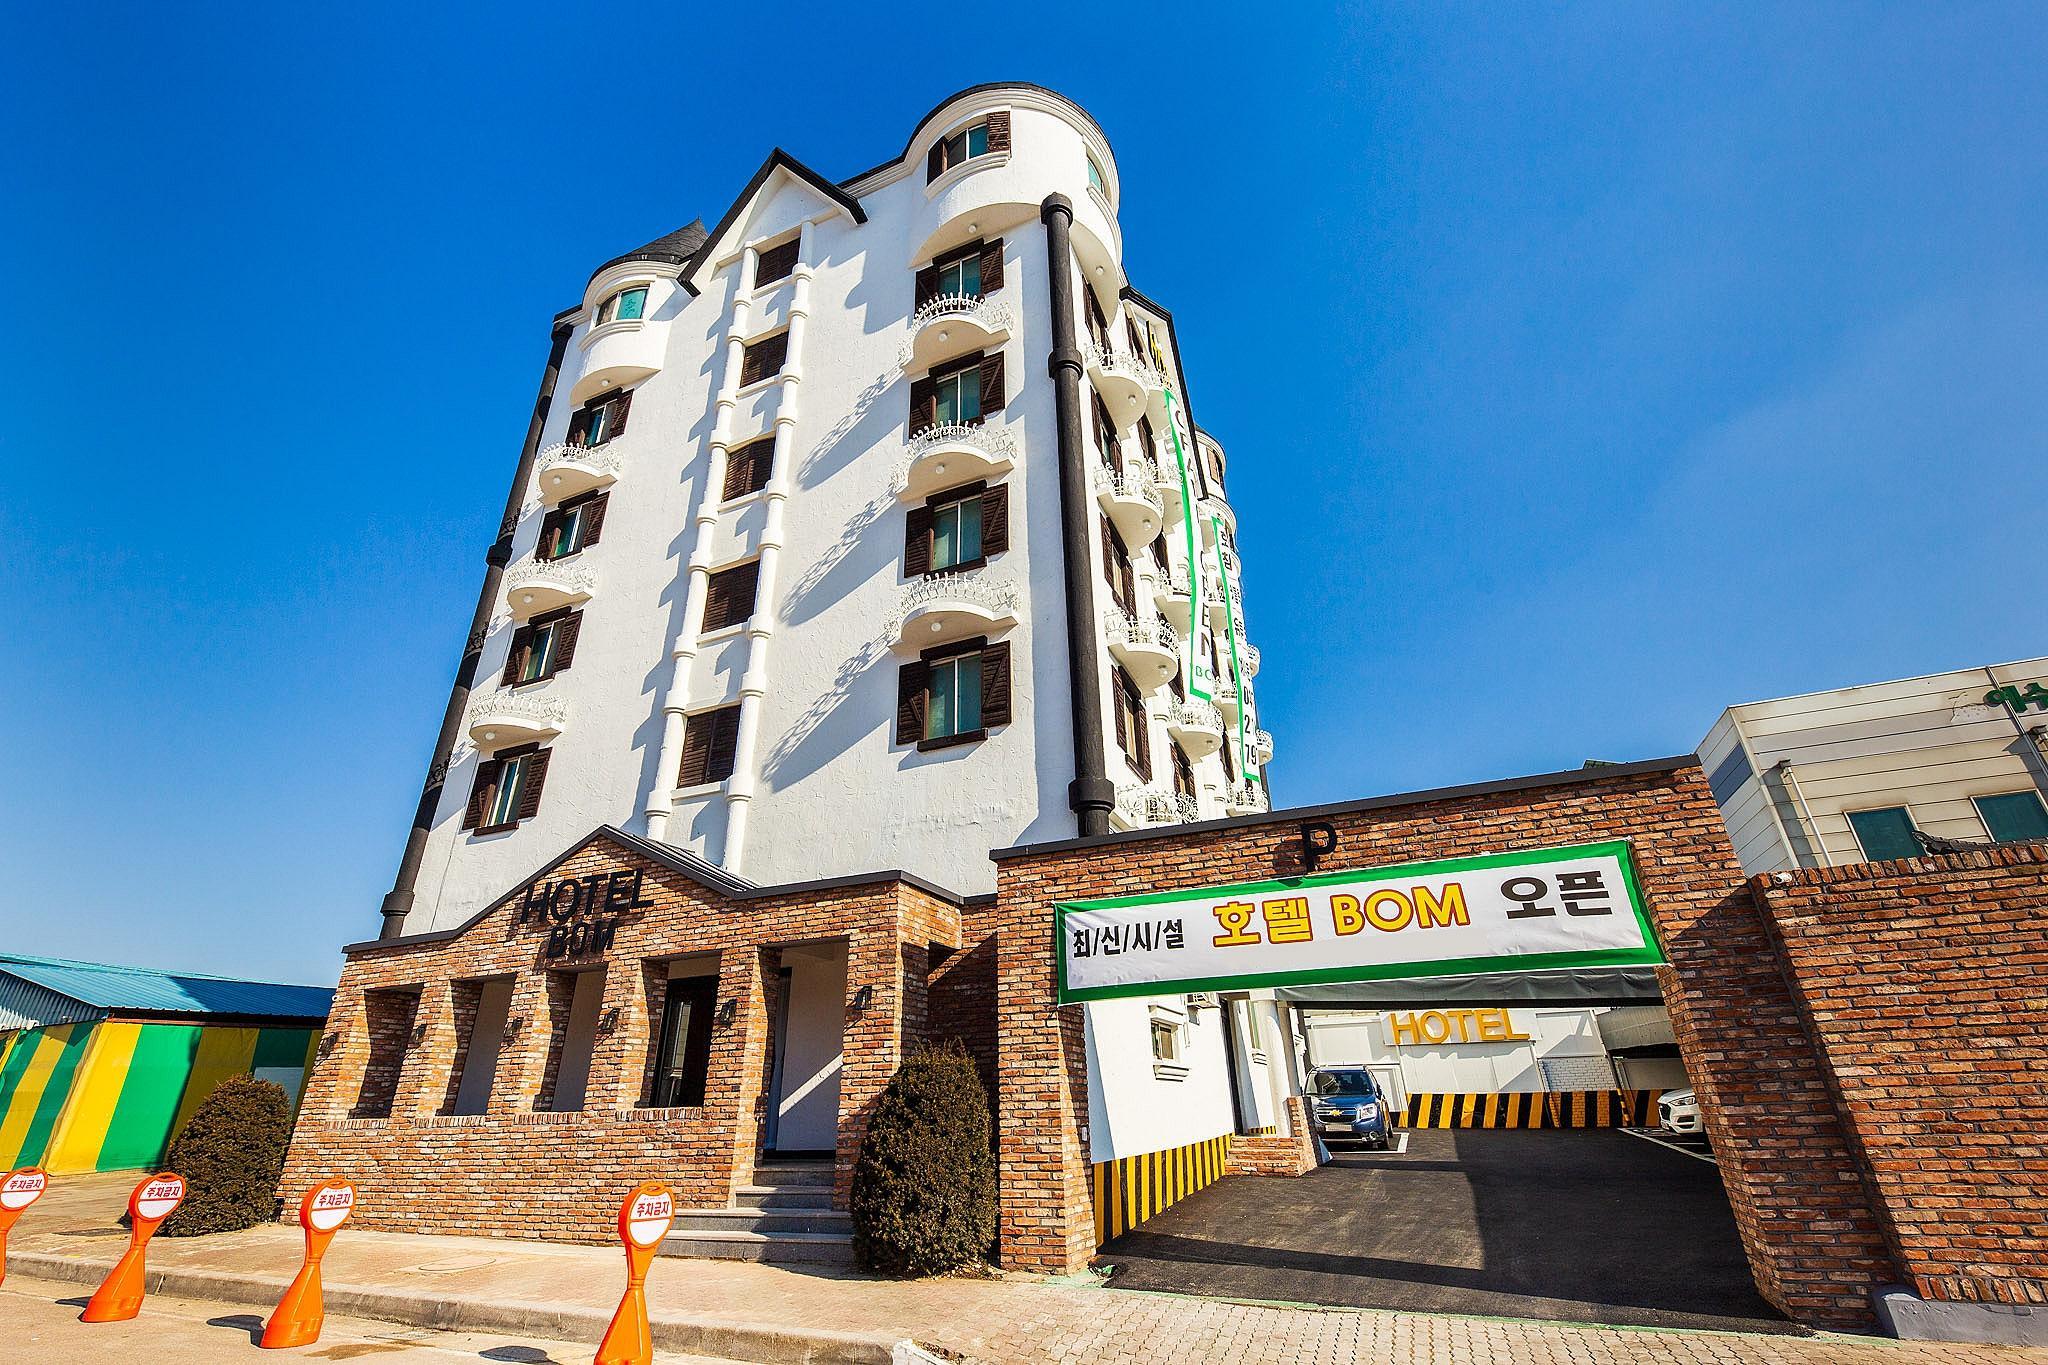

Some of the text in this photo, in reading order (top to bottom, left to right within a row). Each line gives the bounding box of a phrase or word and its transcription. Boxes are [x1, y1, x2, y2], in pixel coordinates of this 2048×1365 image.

[1300, 821, 1337, 873] P
[519, 867, 655, 924] HOTEL
[1212, 896, 1313, 948] 호텔
[1329, 882, 1471, 937] BOM
[1500, 870, 1613, 919] 오픈
[546, 917, 618, 959] BOM
[1389, 998, 1531, 1045] HOTEL
[9, 1178, 43, 1190] 주차금지
[147, 1186, 181, 1198] 주차금지
[318, 1193, 351, 1207] 주차금지
[636, 1200, 670, 1218] 주차금지
